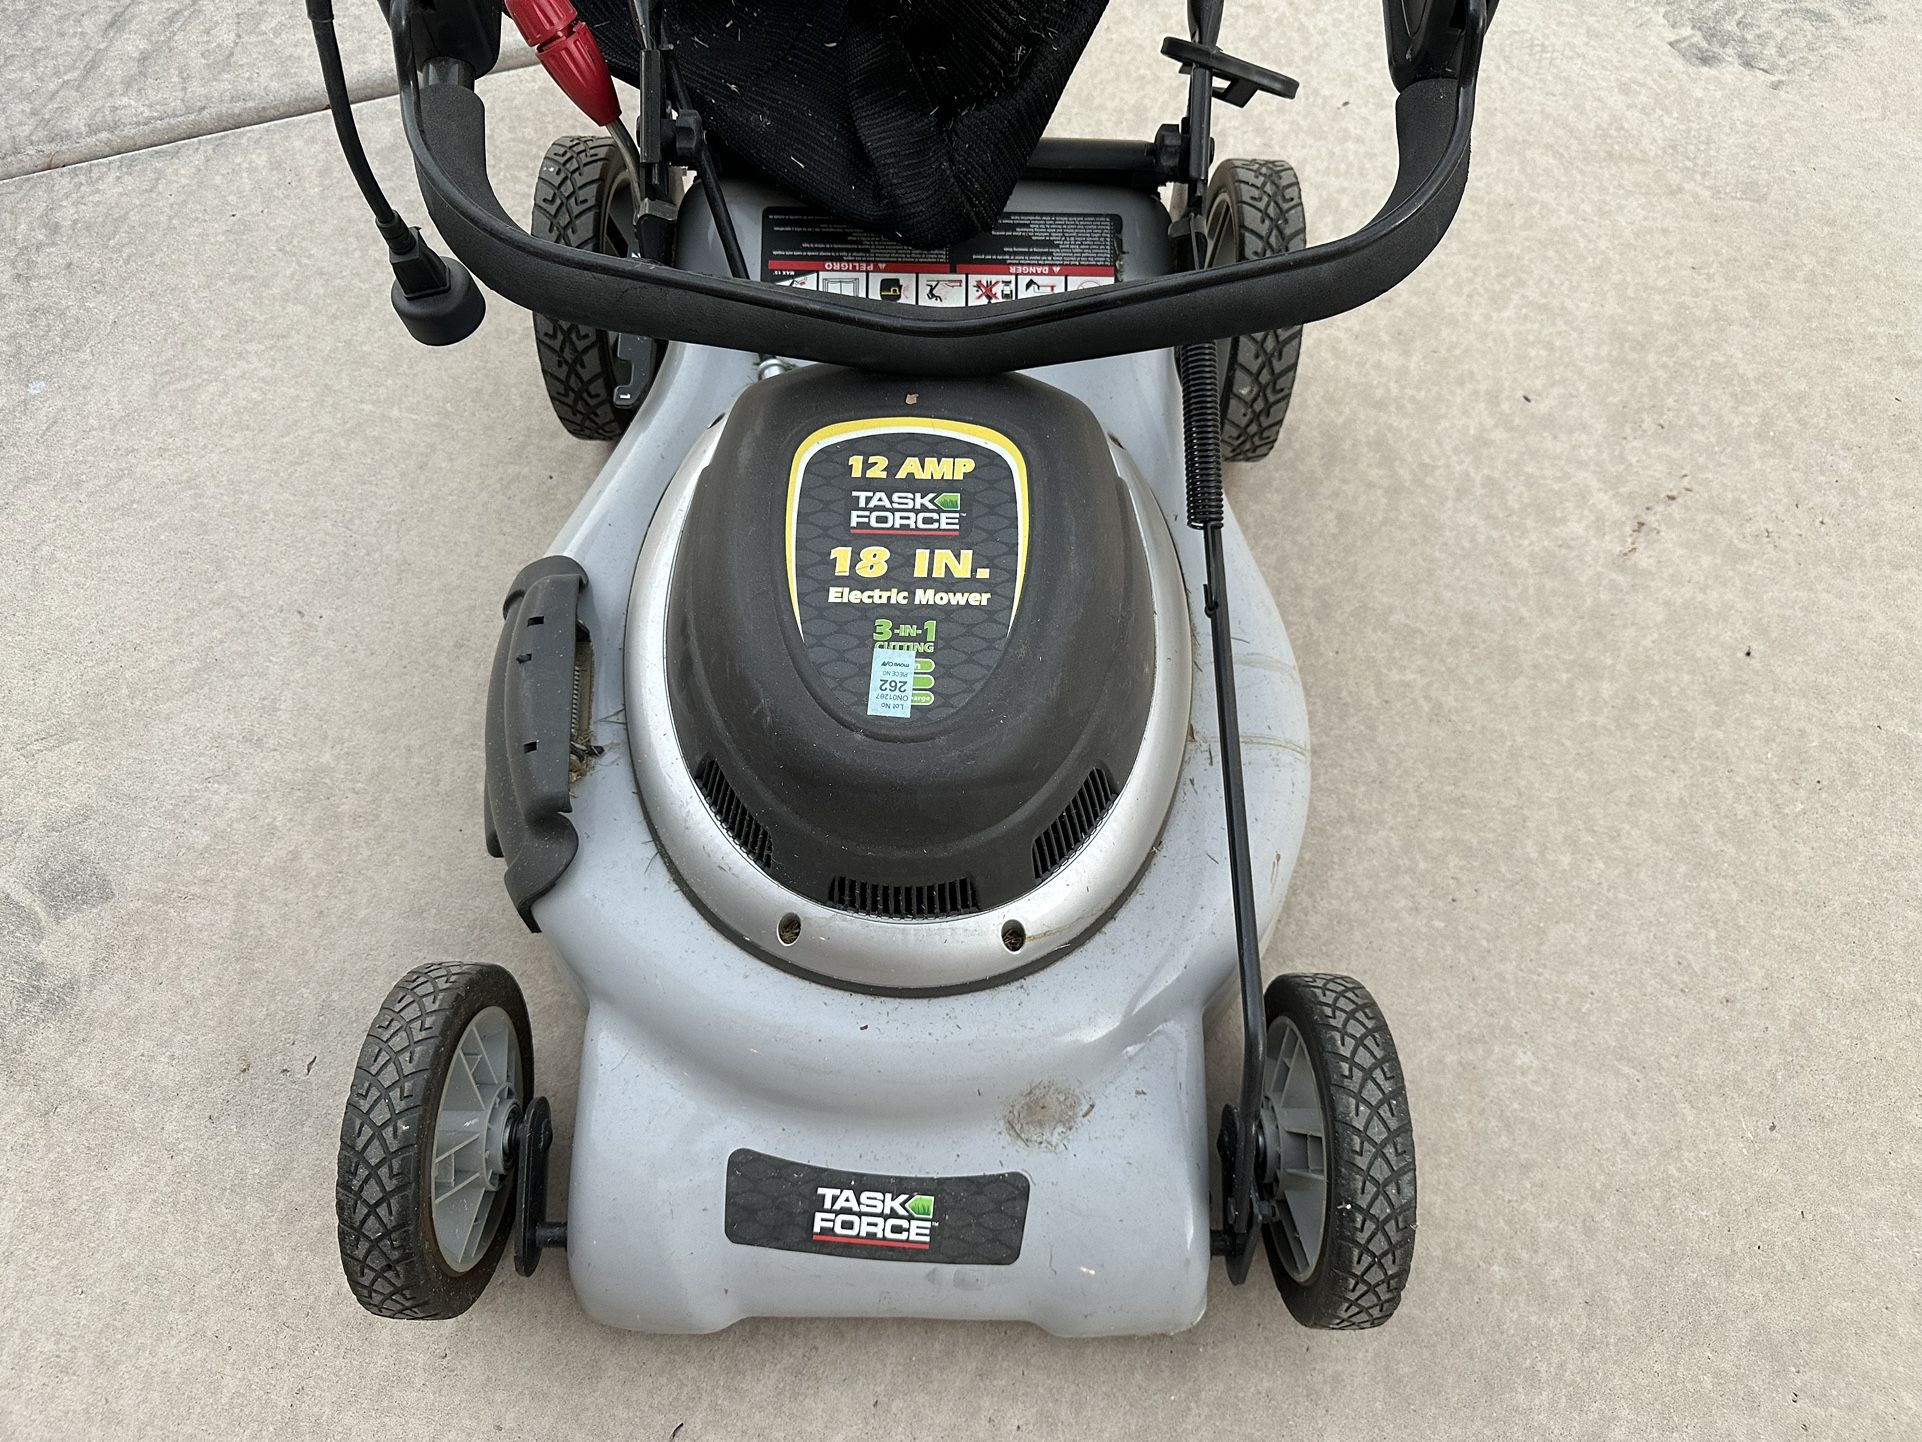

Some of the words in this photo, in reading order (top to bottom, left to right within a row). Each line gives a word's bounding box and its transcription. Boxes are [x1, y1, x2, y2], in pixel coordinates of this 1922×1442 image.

[825, 262, 874, 271] PELIGRO
[1009, 266, 1049, 274] DANGER
[848, 455, 888, 479] 12
[895, 456, 975, 480] AMP
[851, 490, 938, 510] TASK
[850, 510, 960, 530] FORCE
[829, 545, 891, 578] 18
[913, 549, 990, 579] IN.
[827, 586, 909, 605] Electric
[914, 587, 991, 606] Mower
[873, 618, 937, 642] 3-IN-1
[879, 679, 908, 693] 262
[893, 703, 904, 711] Lot
[816, 1186, 910, 1216] TASK
[812, 1211, 931, 1242] FORCE
